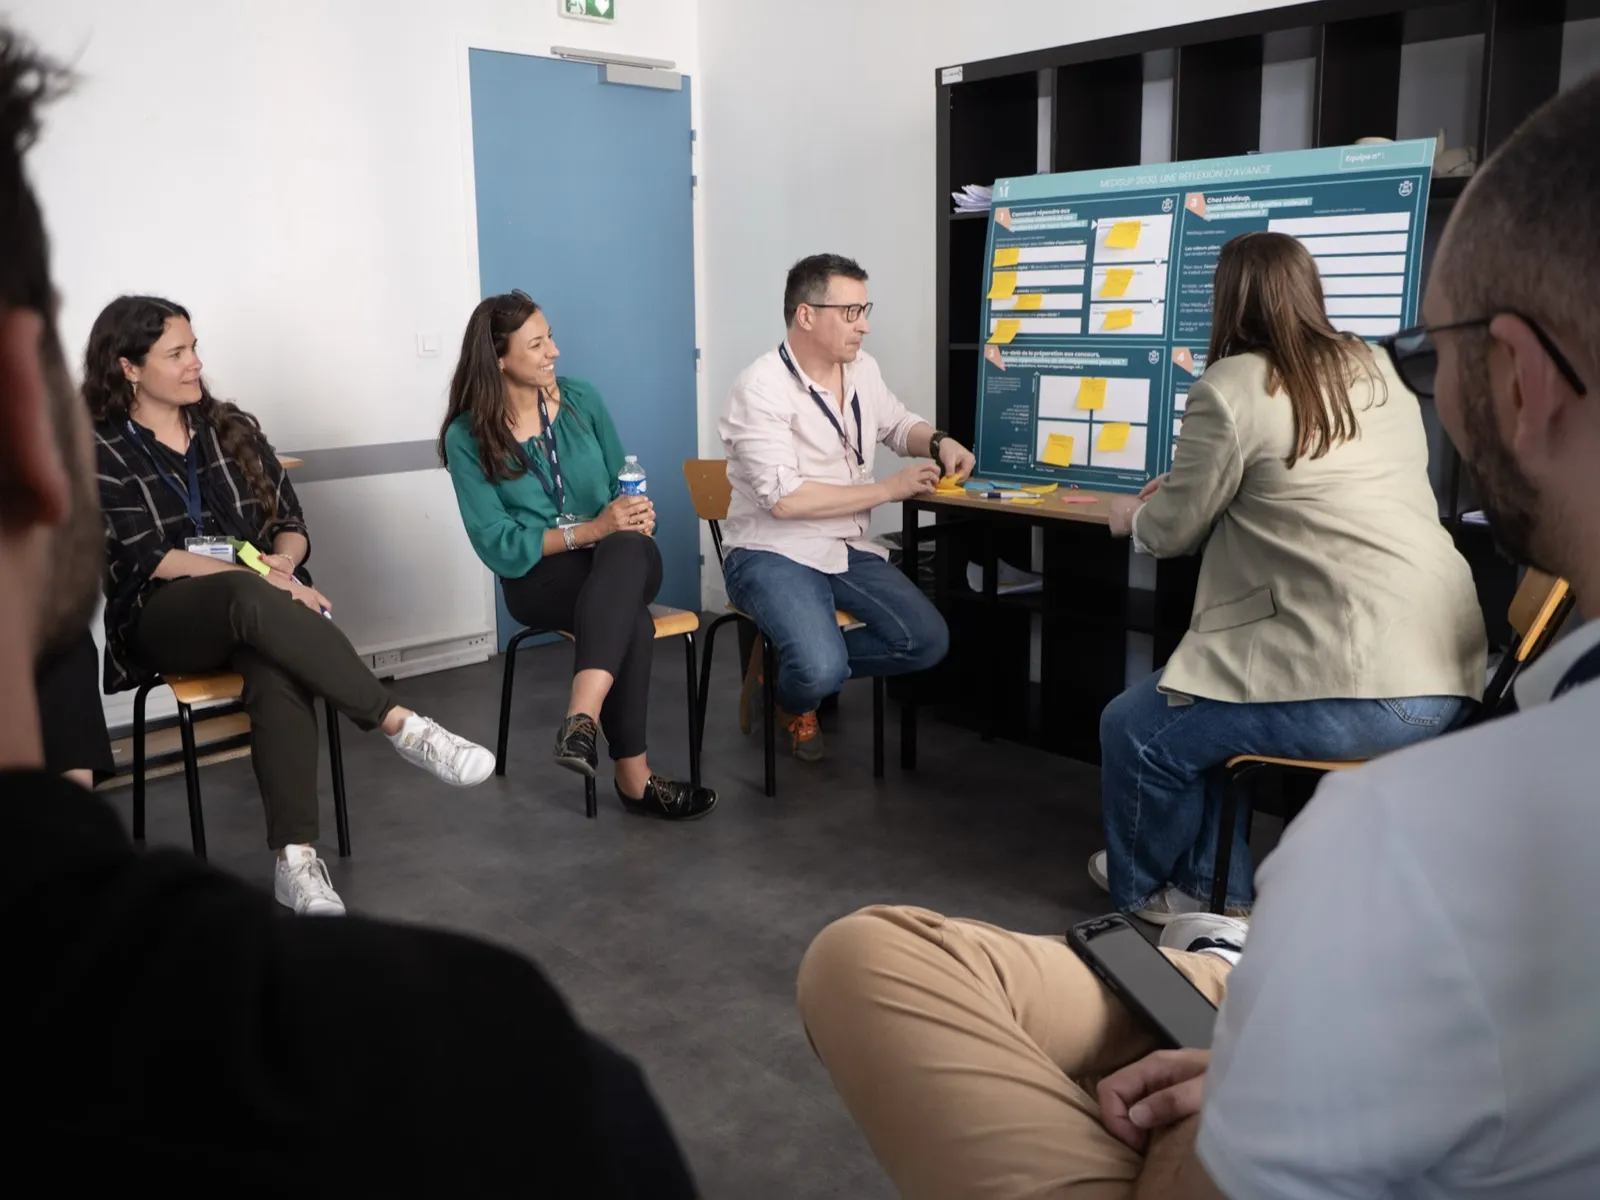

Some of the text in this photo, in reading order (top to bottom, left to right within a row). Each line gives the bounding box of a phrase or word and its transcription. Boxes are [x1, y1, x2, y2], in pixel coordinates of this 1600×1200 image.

[1191, 198, 1197, 207] 3
[1012, 210, 1036, 218] Comment
[1037, 208, 1060, 217] répondre
[1034, 350, 1063, 359] préparation
[1178, 352, 1185, 361] 4
